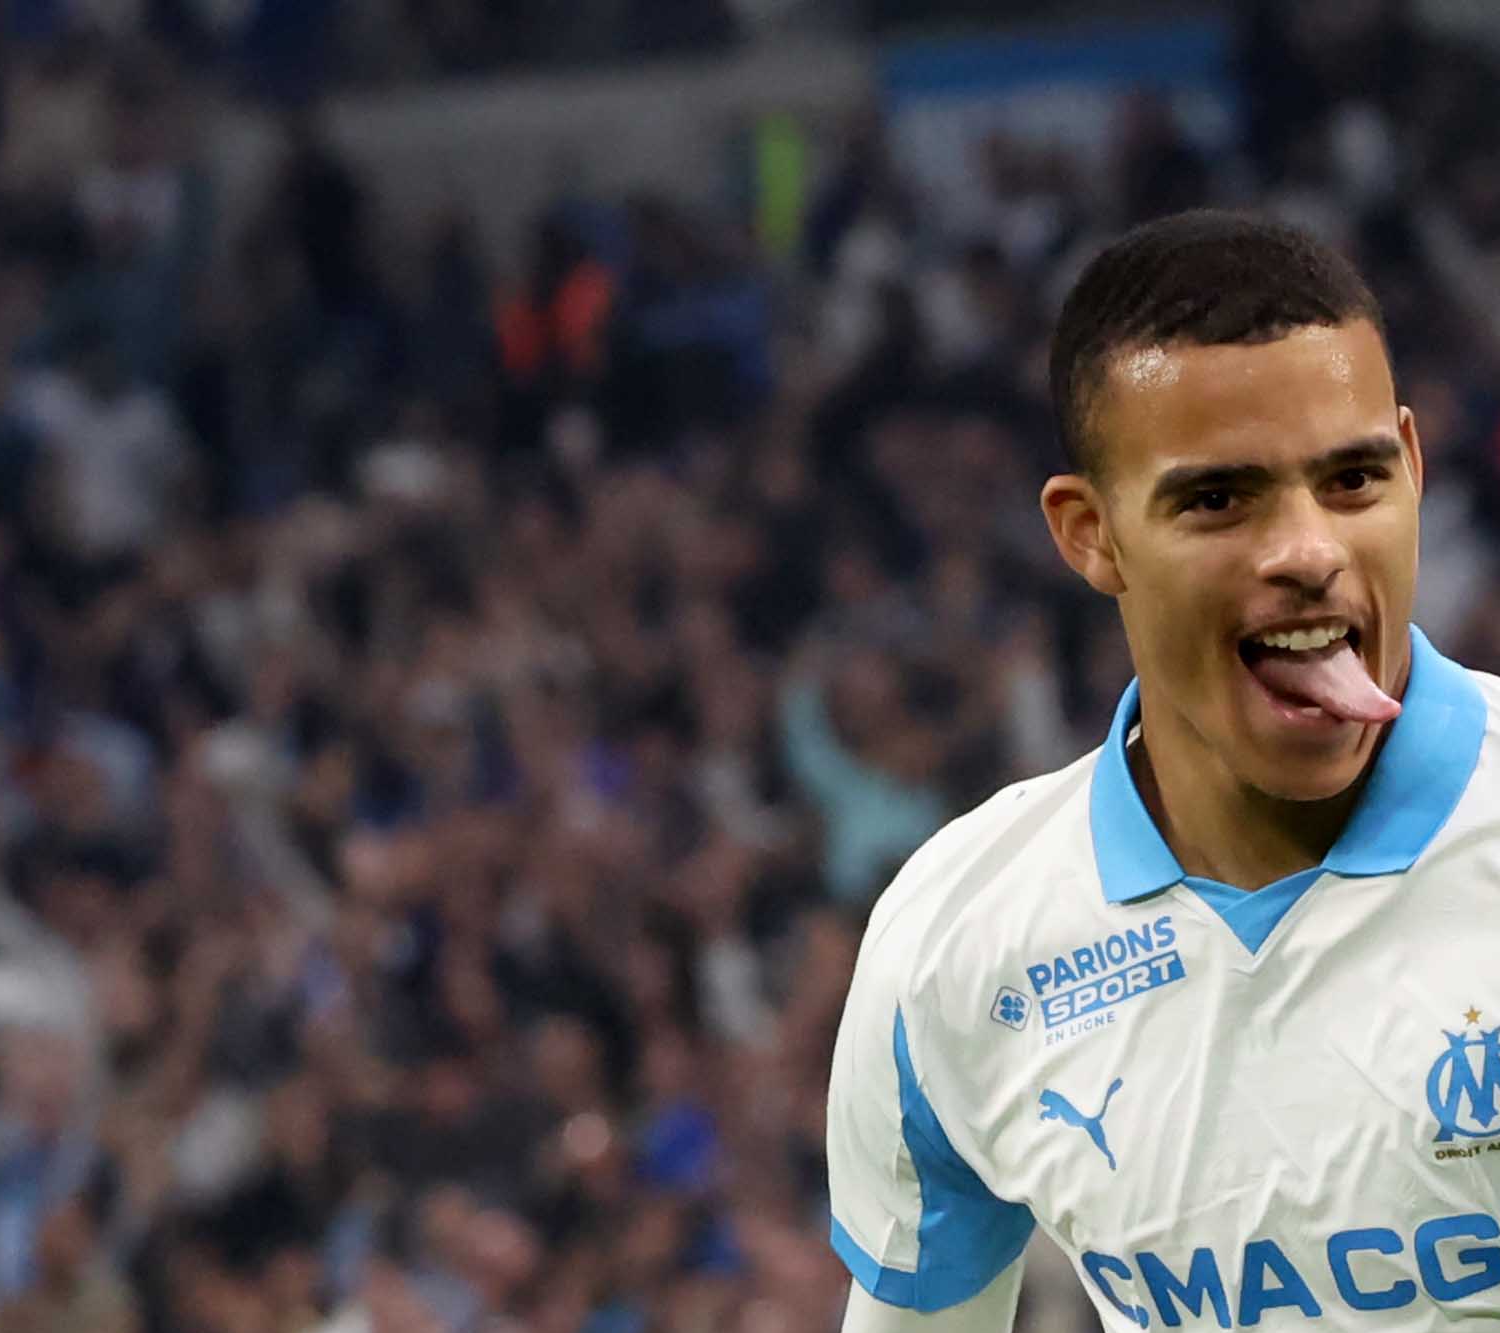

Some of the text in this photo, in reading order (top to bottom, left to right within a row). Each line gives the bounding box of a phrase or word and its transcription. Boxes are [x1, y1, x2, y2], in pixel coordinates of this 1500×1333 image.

[1026, 915, 1177, 995] PARIONS
[1045, 952, 1177, 1023] SPORT
[1044, 1010, 1117, 1047] EN LIGNE
[1080, 1238, 1323, 1330] CMA
